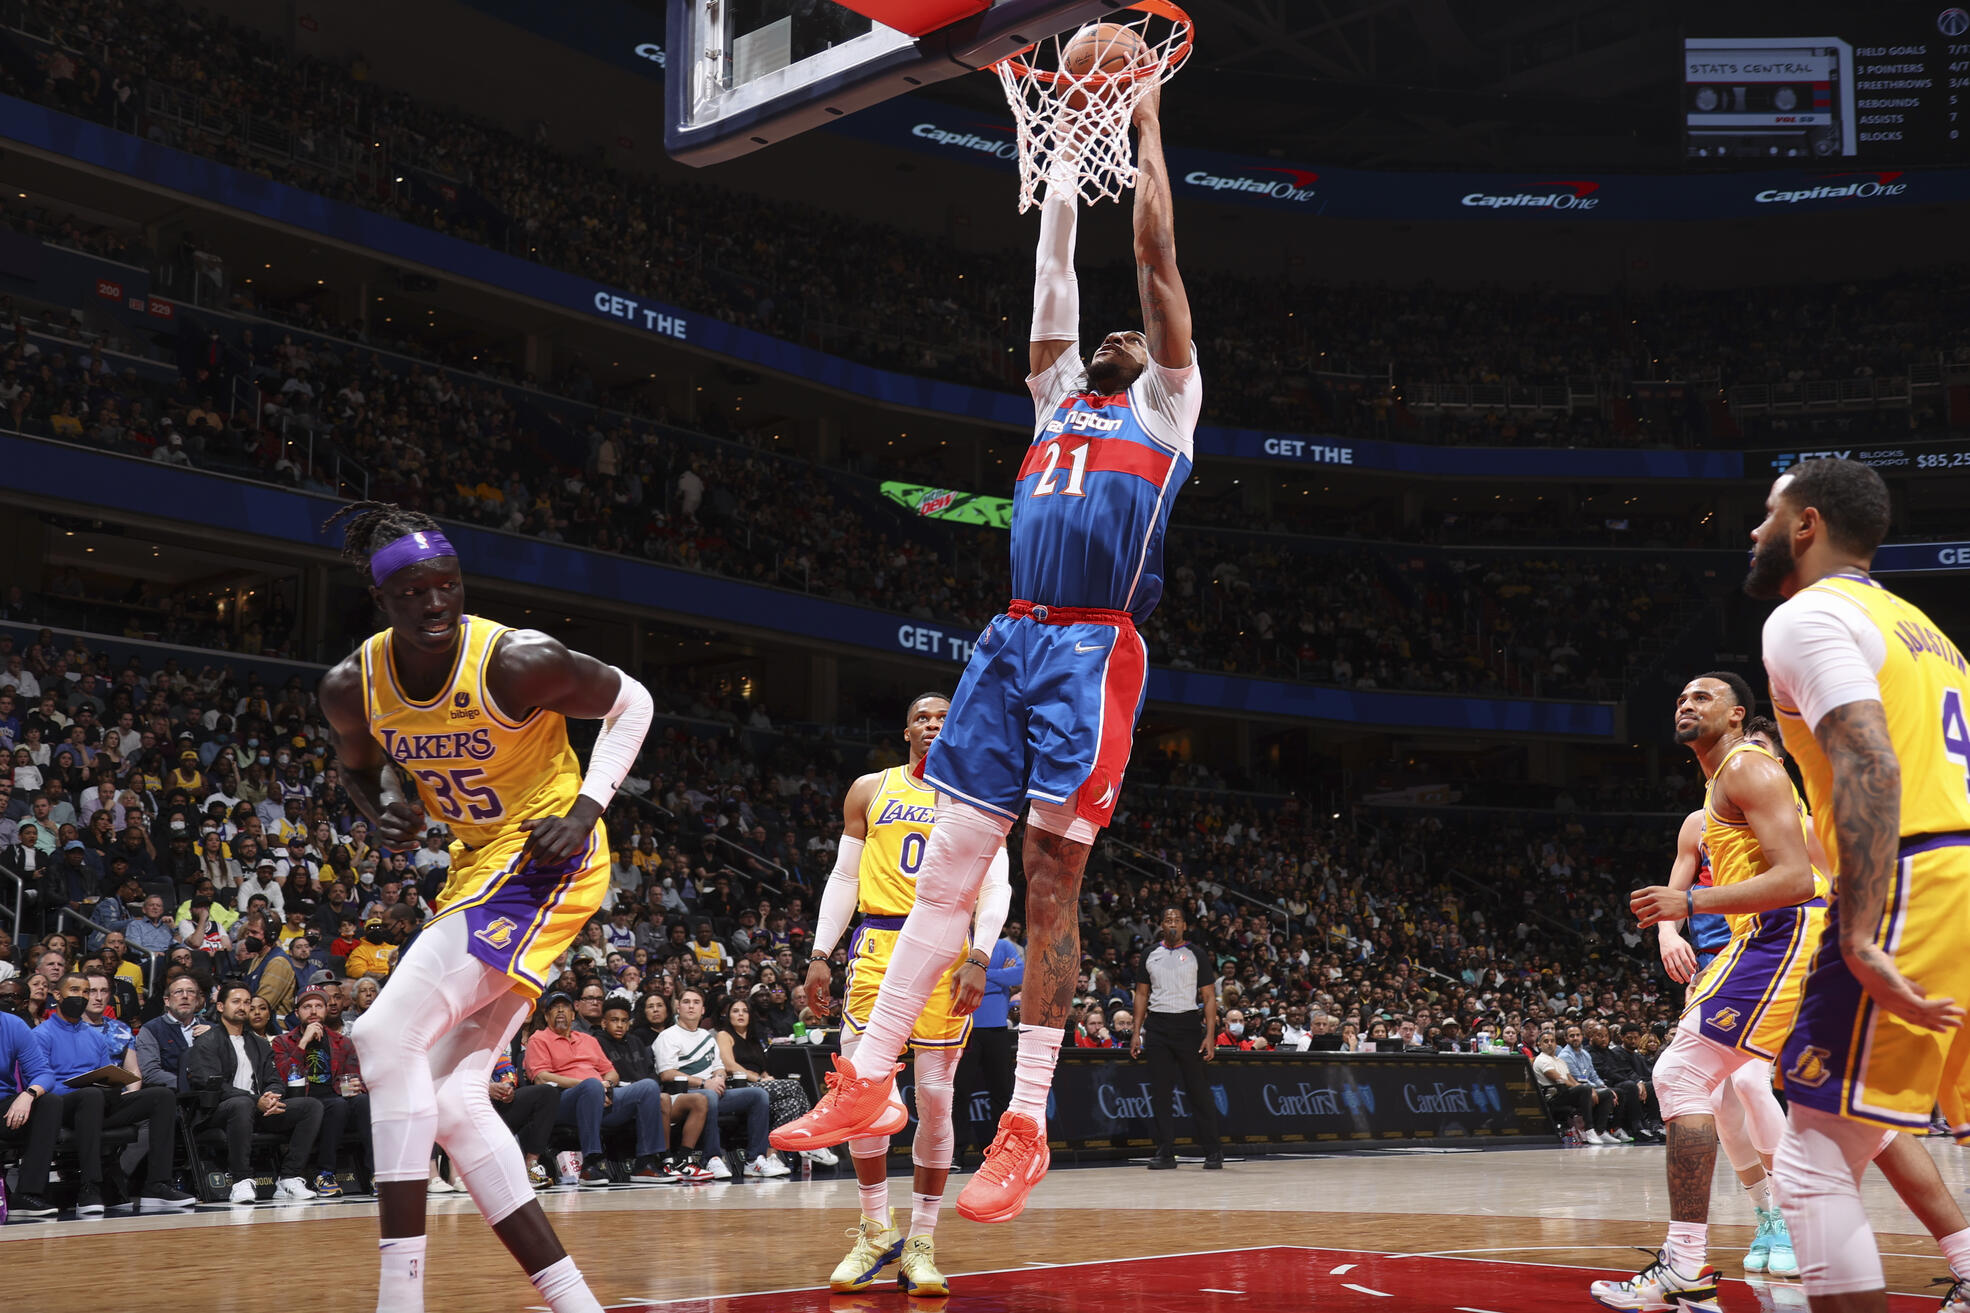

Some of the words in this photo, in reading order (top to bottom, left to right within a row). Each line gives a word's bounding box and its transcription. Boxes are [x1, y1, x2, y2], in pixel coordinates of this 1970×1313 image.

[1856, 47, 1886, 56] FIELD
[1888, 45, 1927, 55] GOALS
[1948, 44, 1970, 55] 7/1
[1690, 64, 1738, 73] STATS
[1743, 63, 1813, 73] CENTRAL
[1857, 65, 1865, 75] 3
[1867, 63, 1925, 74] POINTERS
[1949, 61, 1969, 72] 4/7
[1857, 79, 1933, 90] FREETHROWS
[1949, 77, 1970, 88] 3/4
[1857, 97, 1921, 109] REBOUNDS
[1859, 113, 1905, 125] ASSISTS
[911, 123, 1022, 161] CapitalO
[1859, 130, 1903, 142] BLOCKS
[99, 283, 120, 297] 200
[594, 291, 638, 320] GET
[643, 309, 687, 339] THE
[1264, 438, 1306, 457] GET
[1310, 445, 1353, 464] THE
[1859, 450, 1905, 459] BLOCKS
[1032, 441, 1089, 497] 21
[898, 624, 943, 653] GET
[948, 637, 976, 663] TH
[450, 709, 480, 720] bibigo
[380, 728, 496, 764] LAKERS
[1941, 687, 1970, 795] 4
[412, 767, 506, 824] 35
[874, 798, 936, 826] LAKE
[899, 832, 927, 877] 0
[1097, 1082, 1190, 1119] CareFst
[1263, 1082, 1344, 1116] CareFirst
[1403, 1082, 1472, 1113] CareFirst
